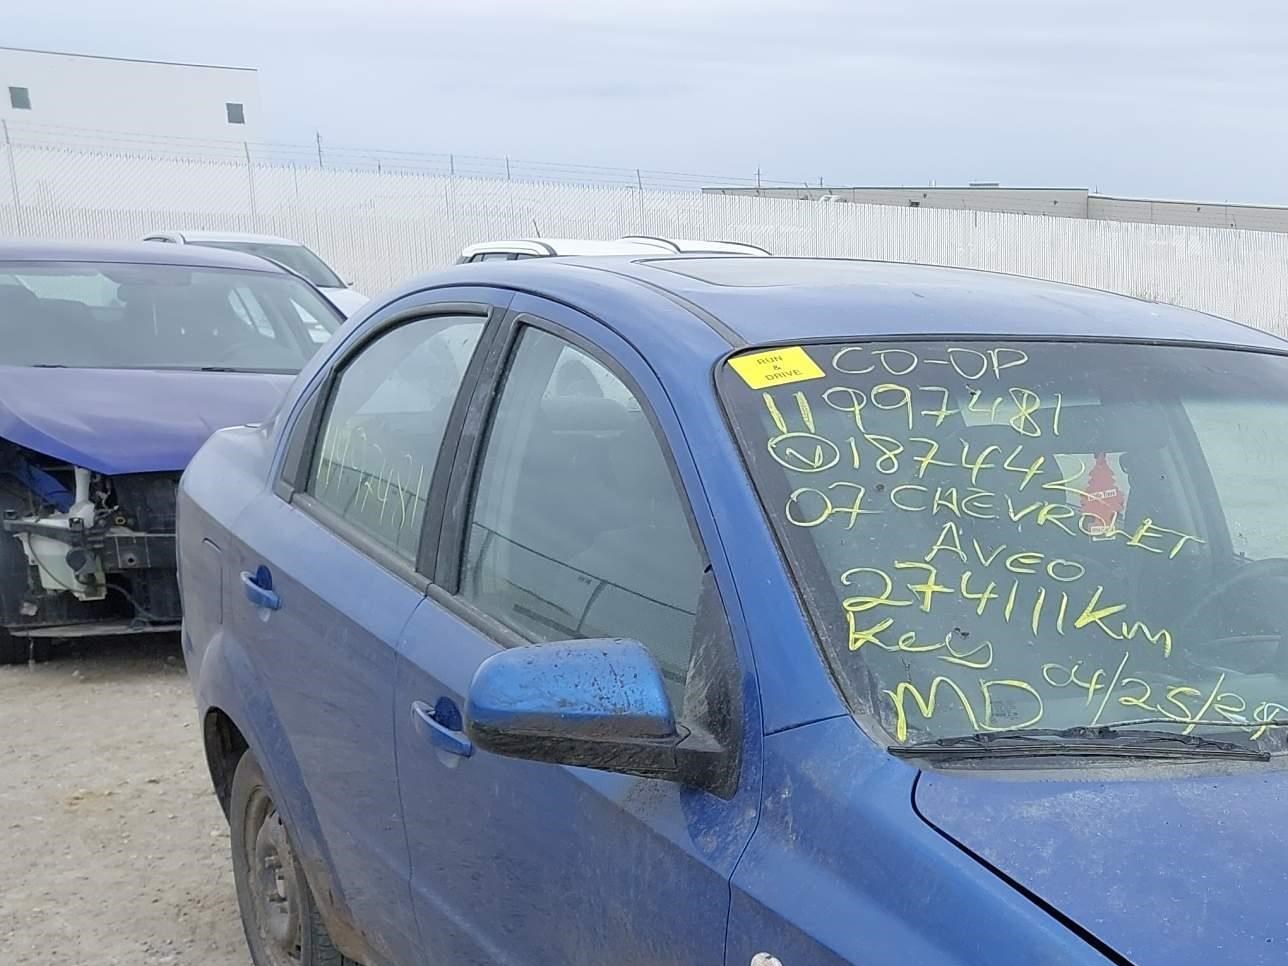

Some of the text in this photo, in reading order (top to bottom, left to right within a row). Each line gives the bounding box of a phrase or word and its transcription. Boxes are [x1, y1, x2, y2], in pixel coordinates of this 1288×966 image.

[757, 355, 783, 365] RUN
[764, 369, 803, 381] DRIVE
[762, 383, 1064, 437] 11997481
[785, 481, 1207, 560] 07 CHEVROLET
[882, 676, 1044, 743] MD
